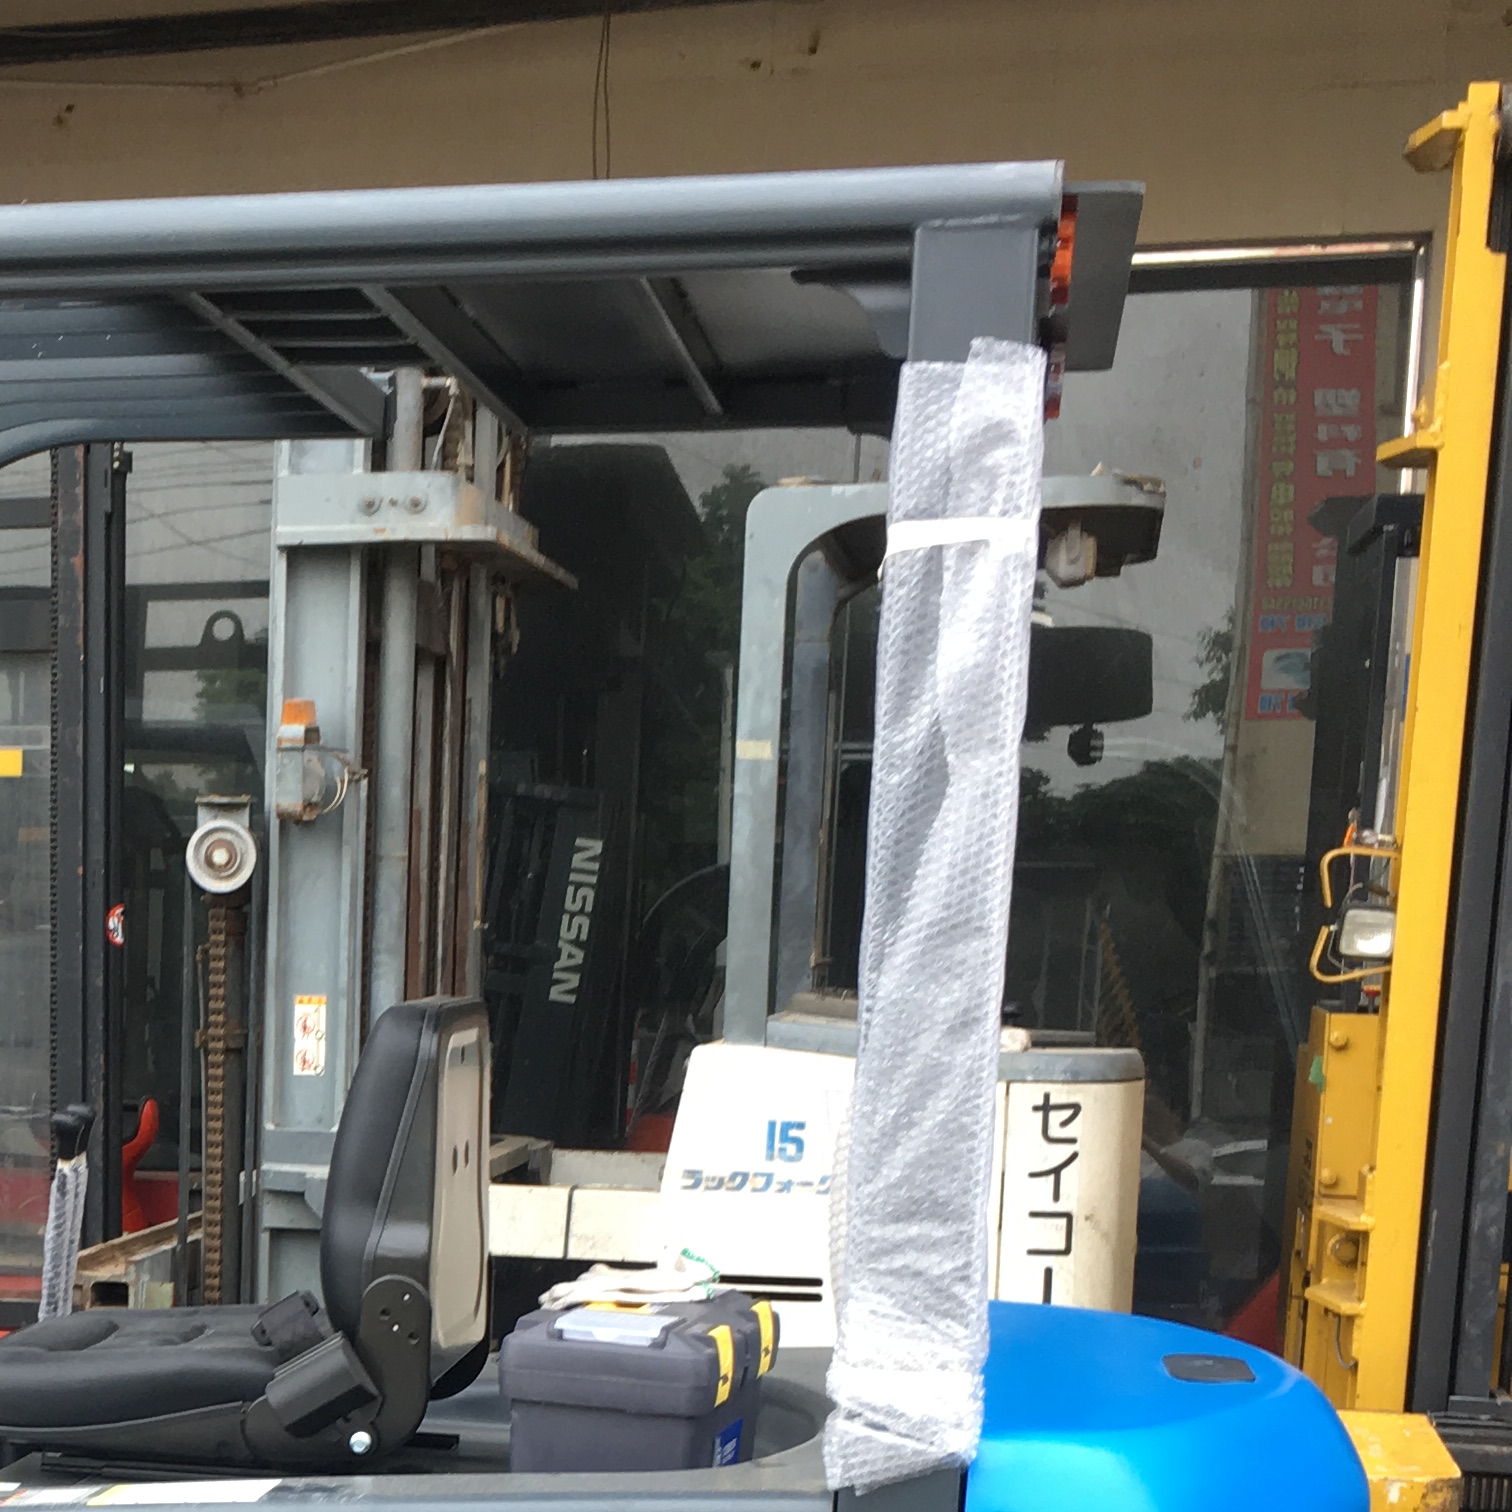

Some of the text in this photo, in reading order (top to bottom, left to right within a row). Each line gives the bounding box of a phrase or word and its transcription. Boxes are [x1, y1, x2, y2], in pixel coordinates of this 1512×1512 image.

[548, 836, 603, 1004] NISSAN
[765, 1120, 807, 1163] 15
[1025, 1091, 1082, 1305] セイコー
